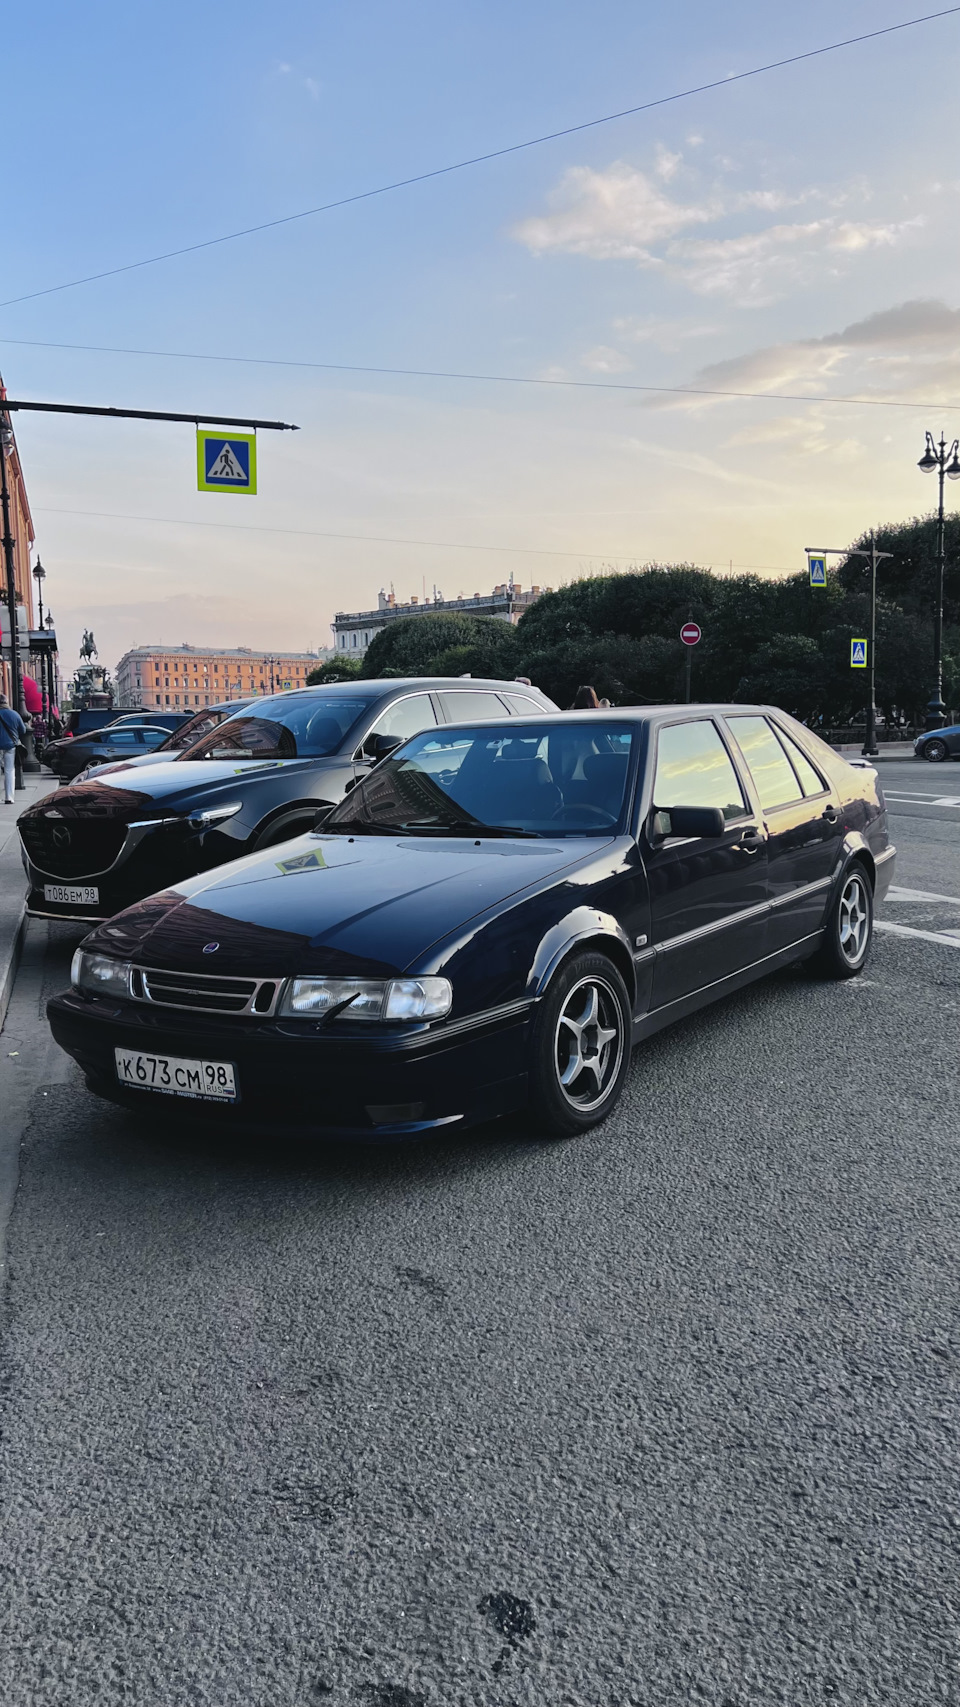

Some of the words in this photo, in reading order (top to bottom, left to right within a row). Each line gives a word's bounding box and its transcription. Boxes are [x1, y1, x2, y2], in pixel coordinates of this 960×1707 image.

[84, 888, 95, 899] 98
[205, 1065, 228, 1086] 98
[206, 1085, 223, 1094] RUS
